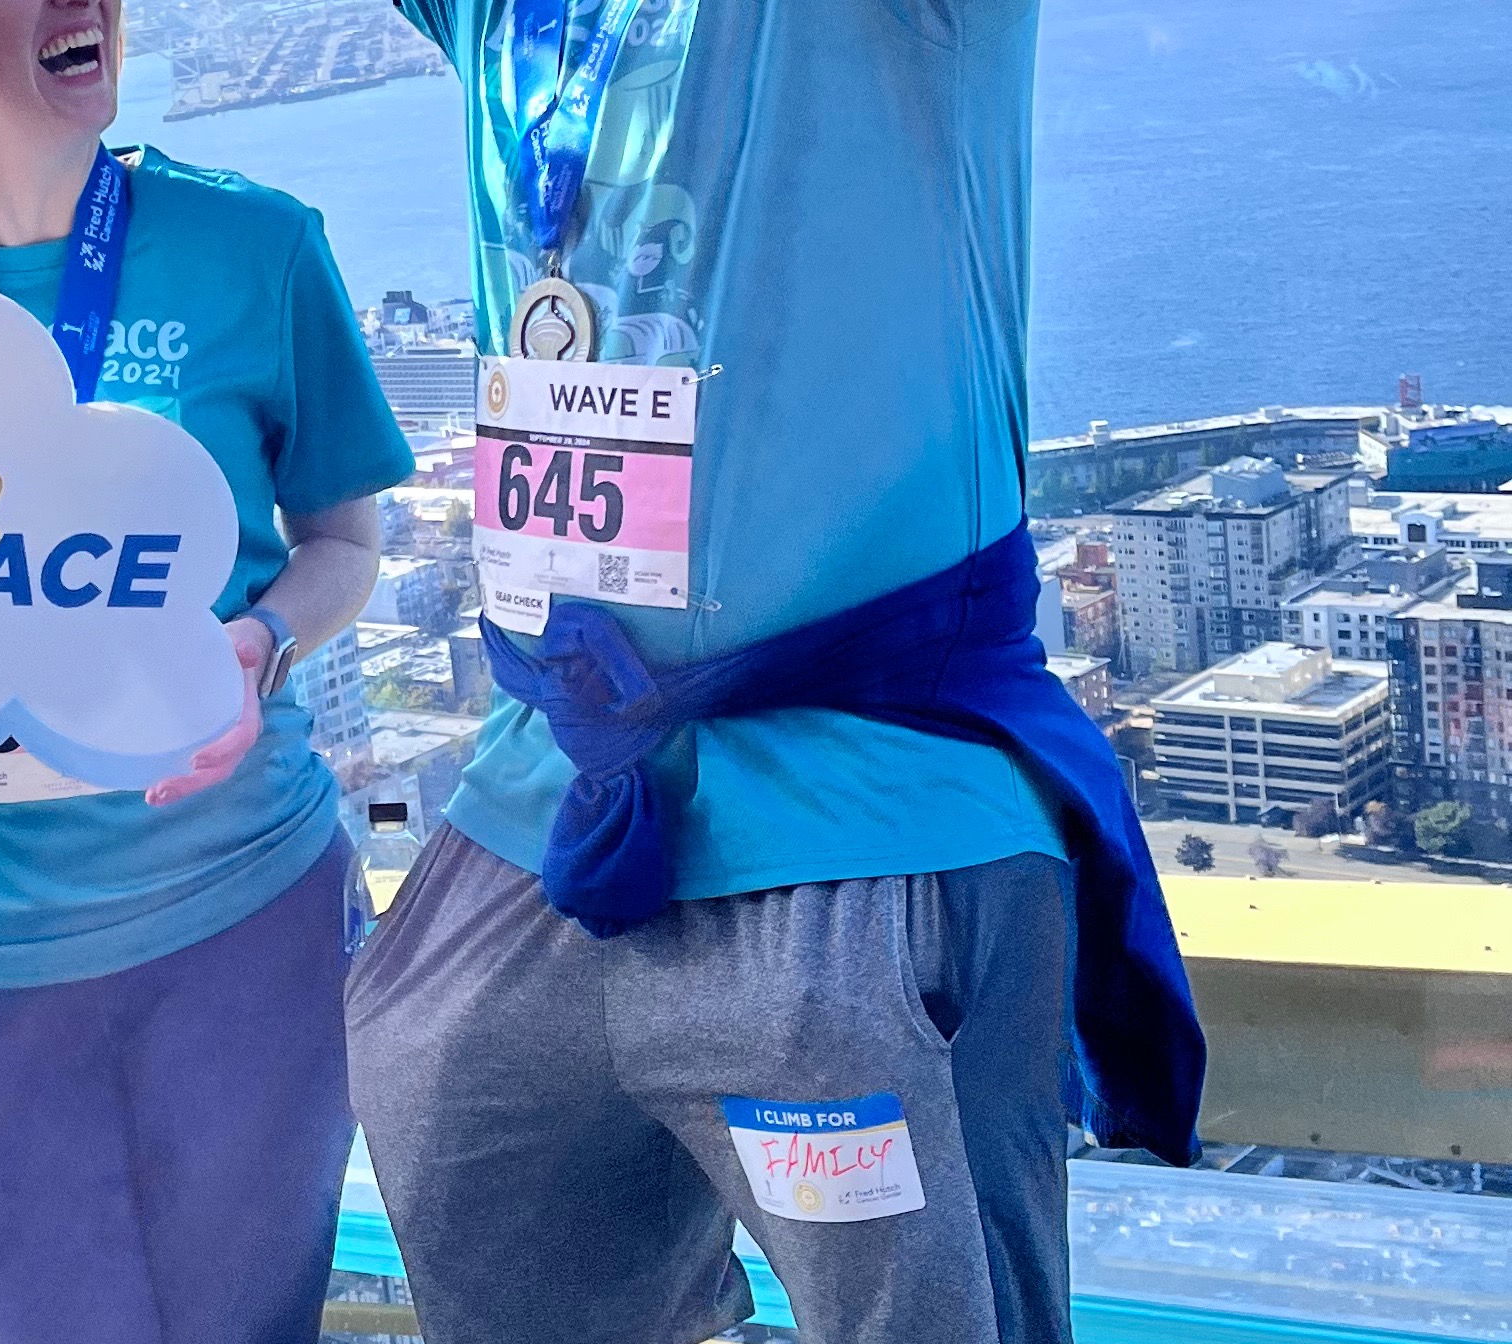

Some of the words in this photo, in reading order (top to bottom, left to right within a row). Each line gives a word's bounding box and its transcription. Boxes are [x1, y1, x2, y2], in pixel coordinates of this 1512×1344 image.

[92, 165, 113, 204] Hutch
[84, 205, 103, 238] Fred
[103, 318, 189, 362] ace
[101, 358, 181, 391] 2024
[549, 383, 638, 417] WAVE
[651, 390, 672, 419] E
[498, 443, 624, 543] 645
[514, 595, 543, 609] CHECK
[755, 1108, 761, 1122] I
[763, 1109, 813, 1127] CLIMB
[816, 1111, 857, 1127] FOR
[760, 1132, 894, 1181] FAMILY
[854, 1189, 874, 1198] Fred
[876, 1183, 901, 1196] Hutch
